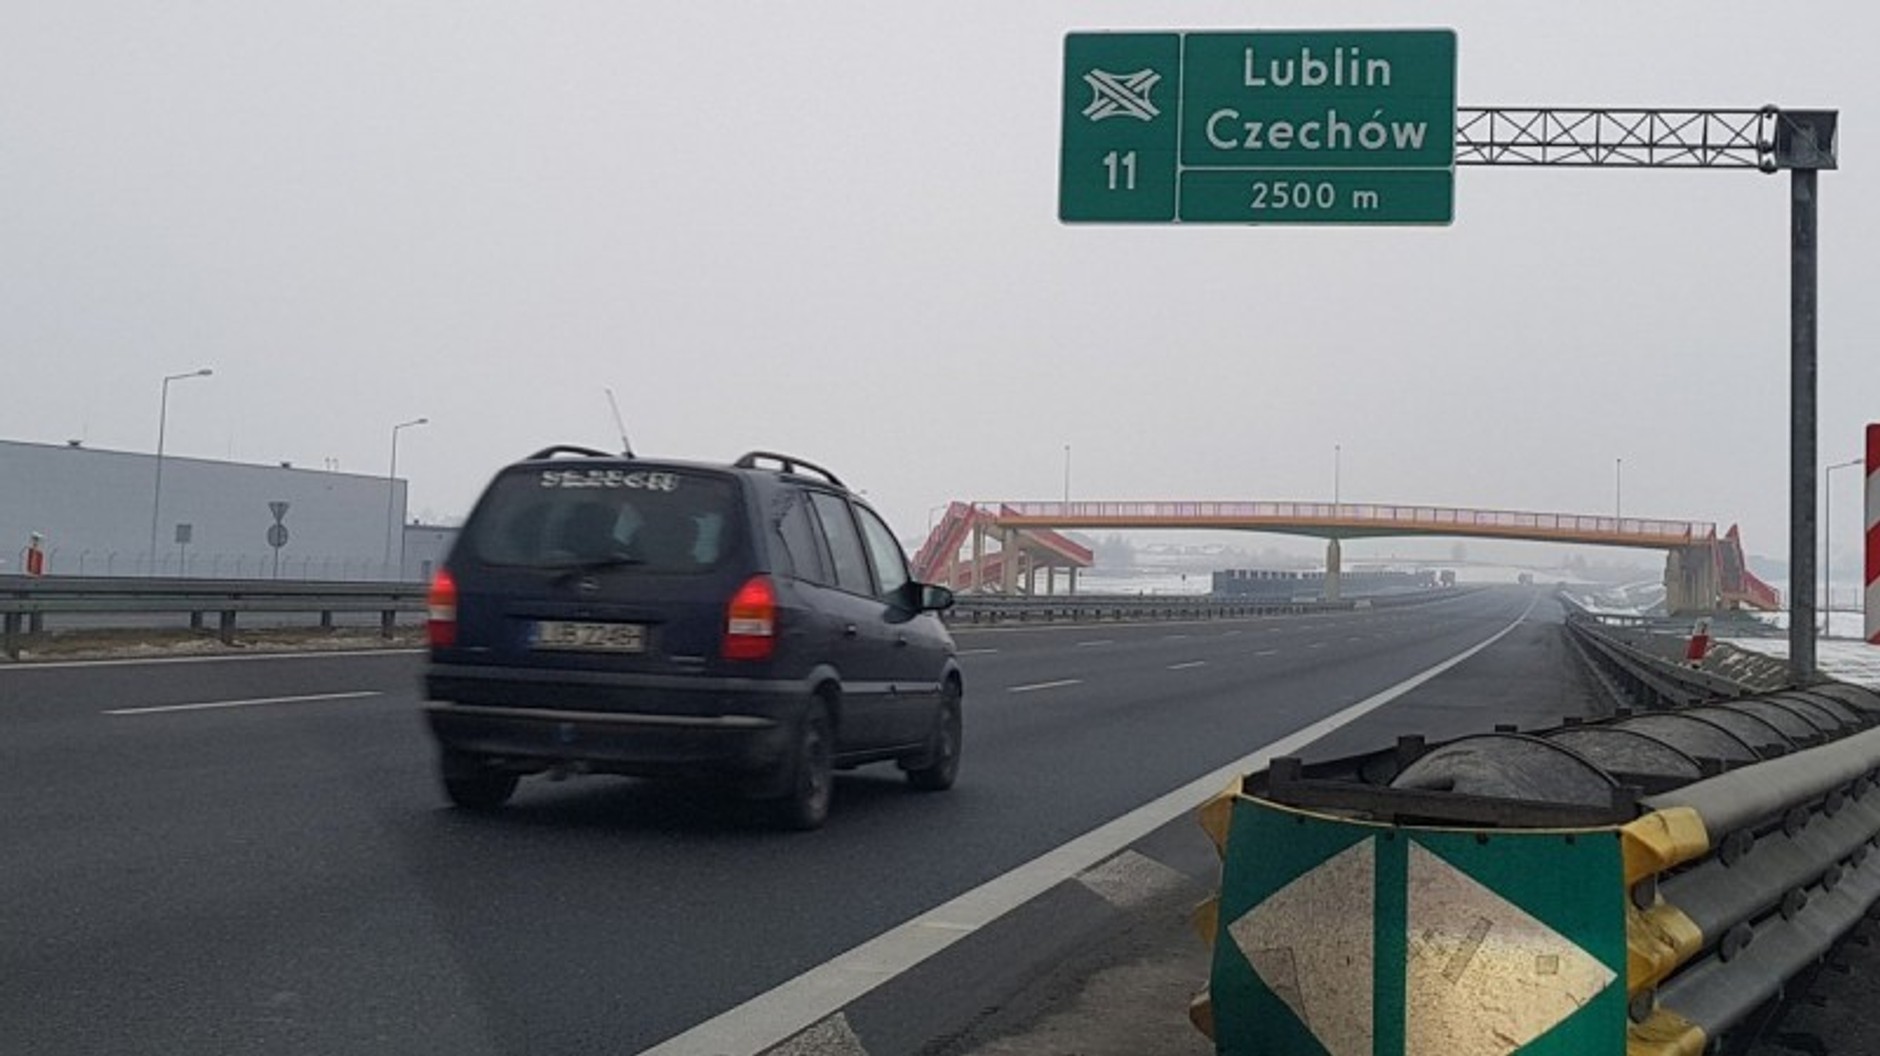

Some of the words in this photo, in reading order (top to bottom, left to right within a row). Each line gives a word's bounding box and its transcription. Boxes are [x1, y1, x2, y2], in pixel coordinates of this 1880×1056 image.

[1245, 48, 1391, 86] Lublin
[1206, 109, 1428, 149] Czechów
[1103, 151, 1136, 189] 11
[1251, 183, 1335, 208] 2500
[1353, 191, 1379, 208] m
